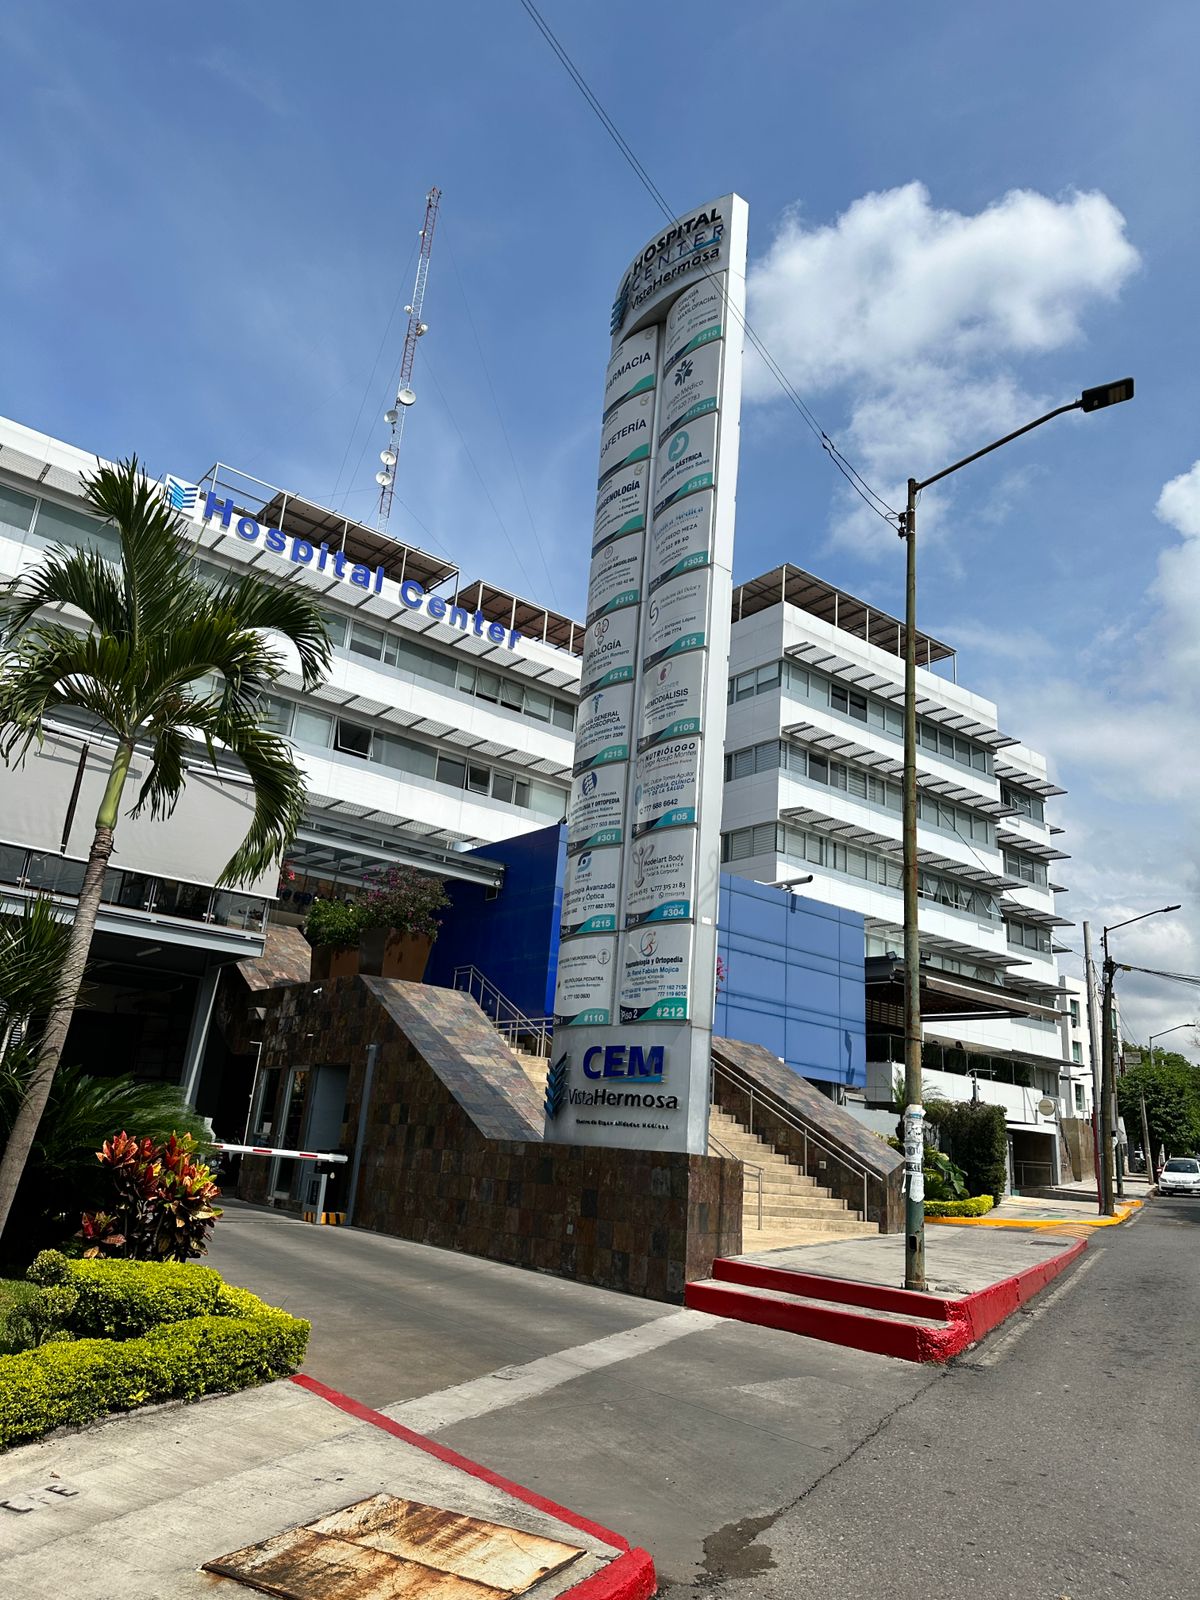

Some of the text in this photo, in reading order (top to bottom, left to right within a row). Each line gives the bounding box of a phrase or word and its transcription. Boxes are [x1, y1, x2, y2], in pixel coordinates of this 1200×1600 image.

[633, 208, 721, 276] HOSPITAL
[632, 224, 724, 292] CENTER
[630, 247, 720, 310] VistaHermosa
[601, 418, 647, 458] CAFETERÍA
[202, 490, 385, 594] Hospital
[399, 578, 523, 651] Center
[593, 710, 620, 722] GENERAL
[673, 722, 695, 733] #109
[603, 749, 623, 759] #215
[645, 742, 696, 761] NUTRIÓLOGO
[670, 777, 695, 786] CLÍNICA
[666, 784, 685, 792] SALUD
[672, 812, 688, 822] #05
[597, 833, 616, 842] #301
[585, 882, 616, 891] Avanzada
[663, 908, 685, 917] #304
[592, 919, 611, 929] #215
[655, 956, 683, 964] Ortopedia
[659, 966, 680, 974] Mojica
[656, 1007, 684, 1017] #212
[584, 1014, 604, 1022] #110
[583, 1045, 665, 1080] CEM
[568, 1088, 679, 1110] VistaHermosa
[0, 1484, 80, 1514] CE
